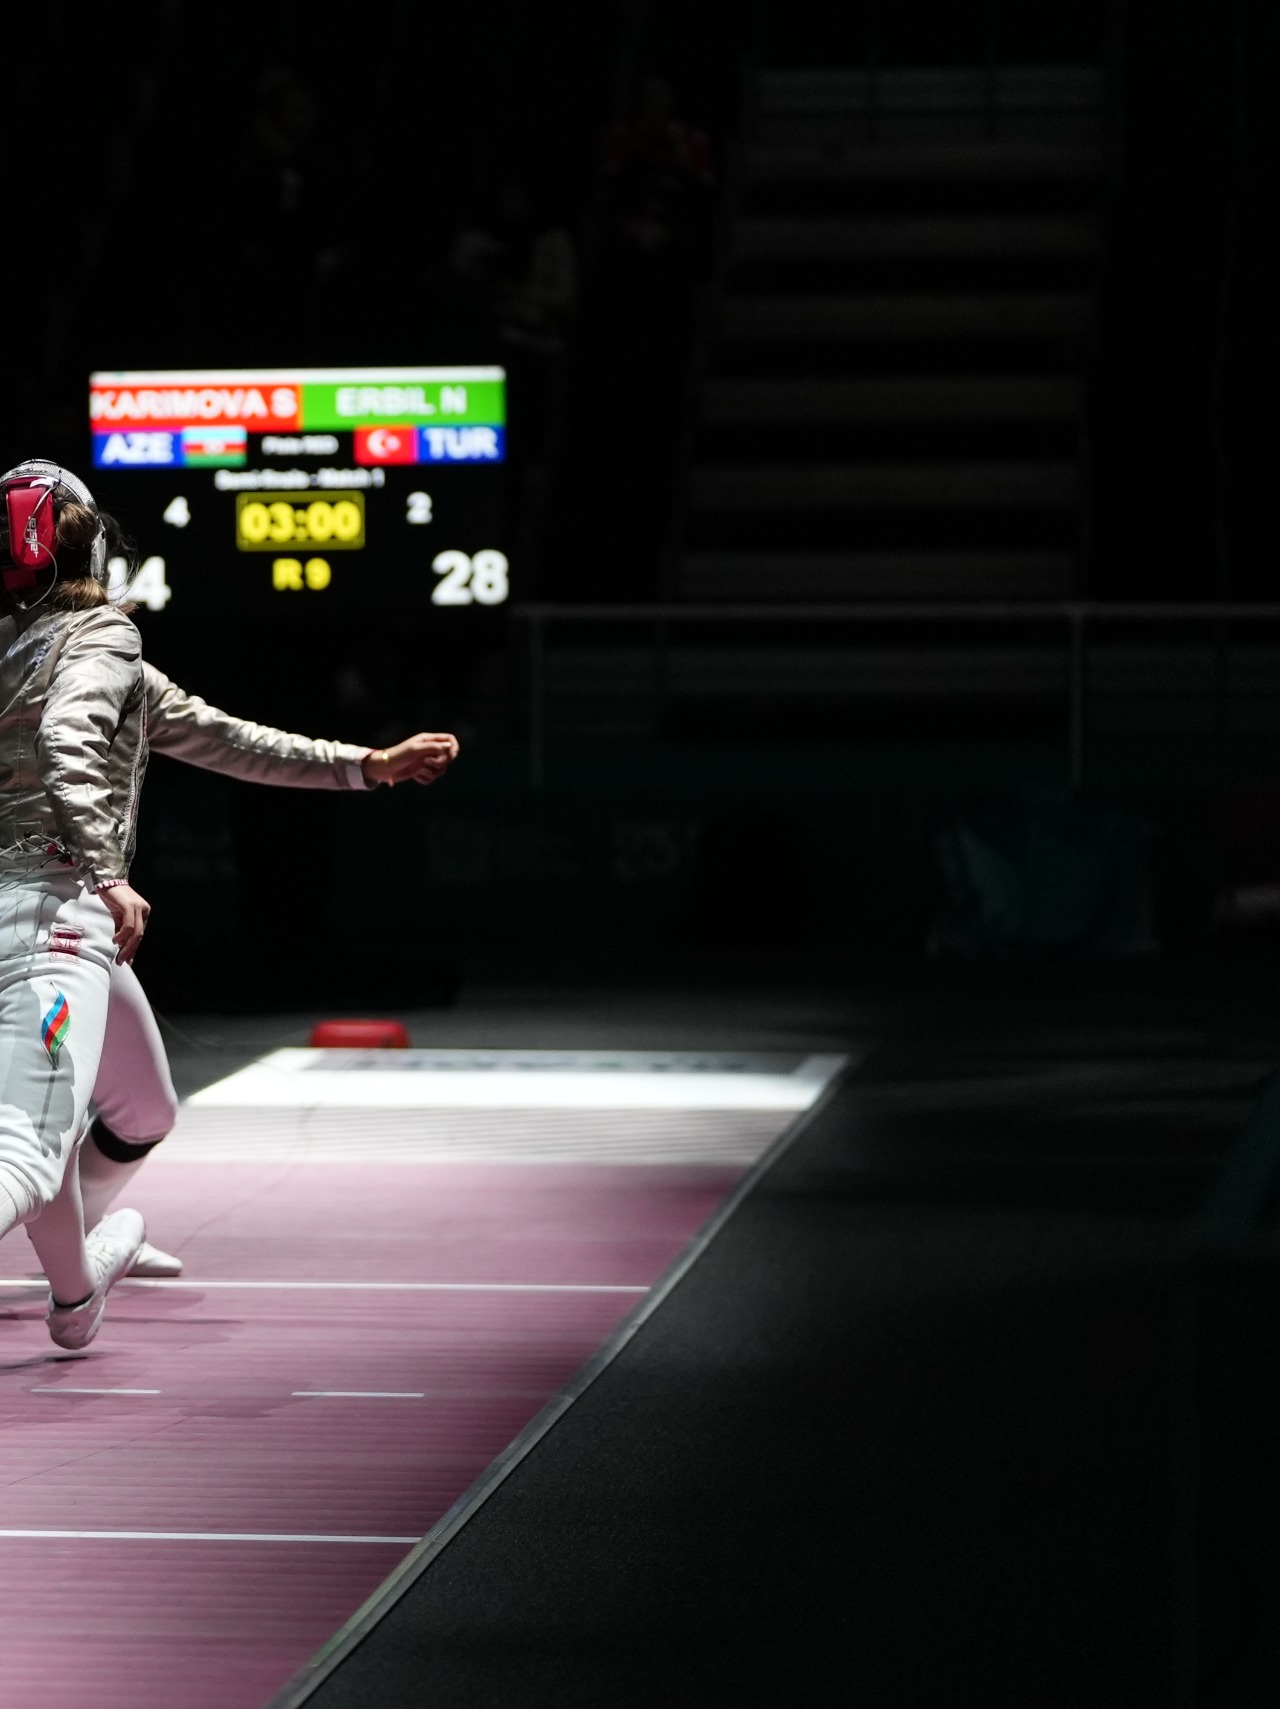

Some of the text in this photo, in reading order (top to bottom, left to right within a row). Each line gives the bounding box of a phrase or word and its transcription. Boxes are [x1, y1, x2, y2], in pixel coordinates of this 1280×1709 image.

[90, 388, 298, 418] KARIMOVA S
[336, 386, 467, 416] ERBIL N
[101, 433, 174, 463] AZE
[424, 428, 499, 458] TUR
[163, 496, 190, 528] 4
[241, 501, 361, 542] 03:00
[406, 491, 433, 524] 2
[431, 549, 508, 605] 28
